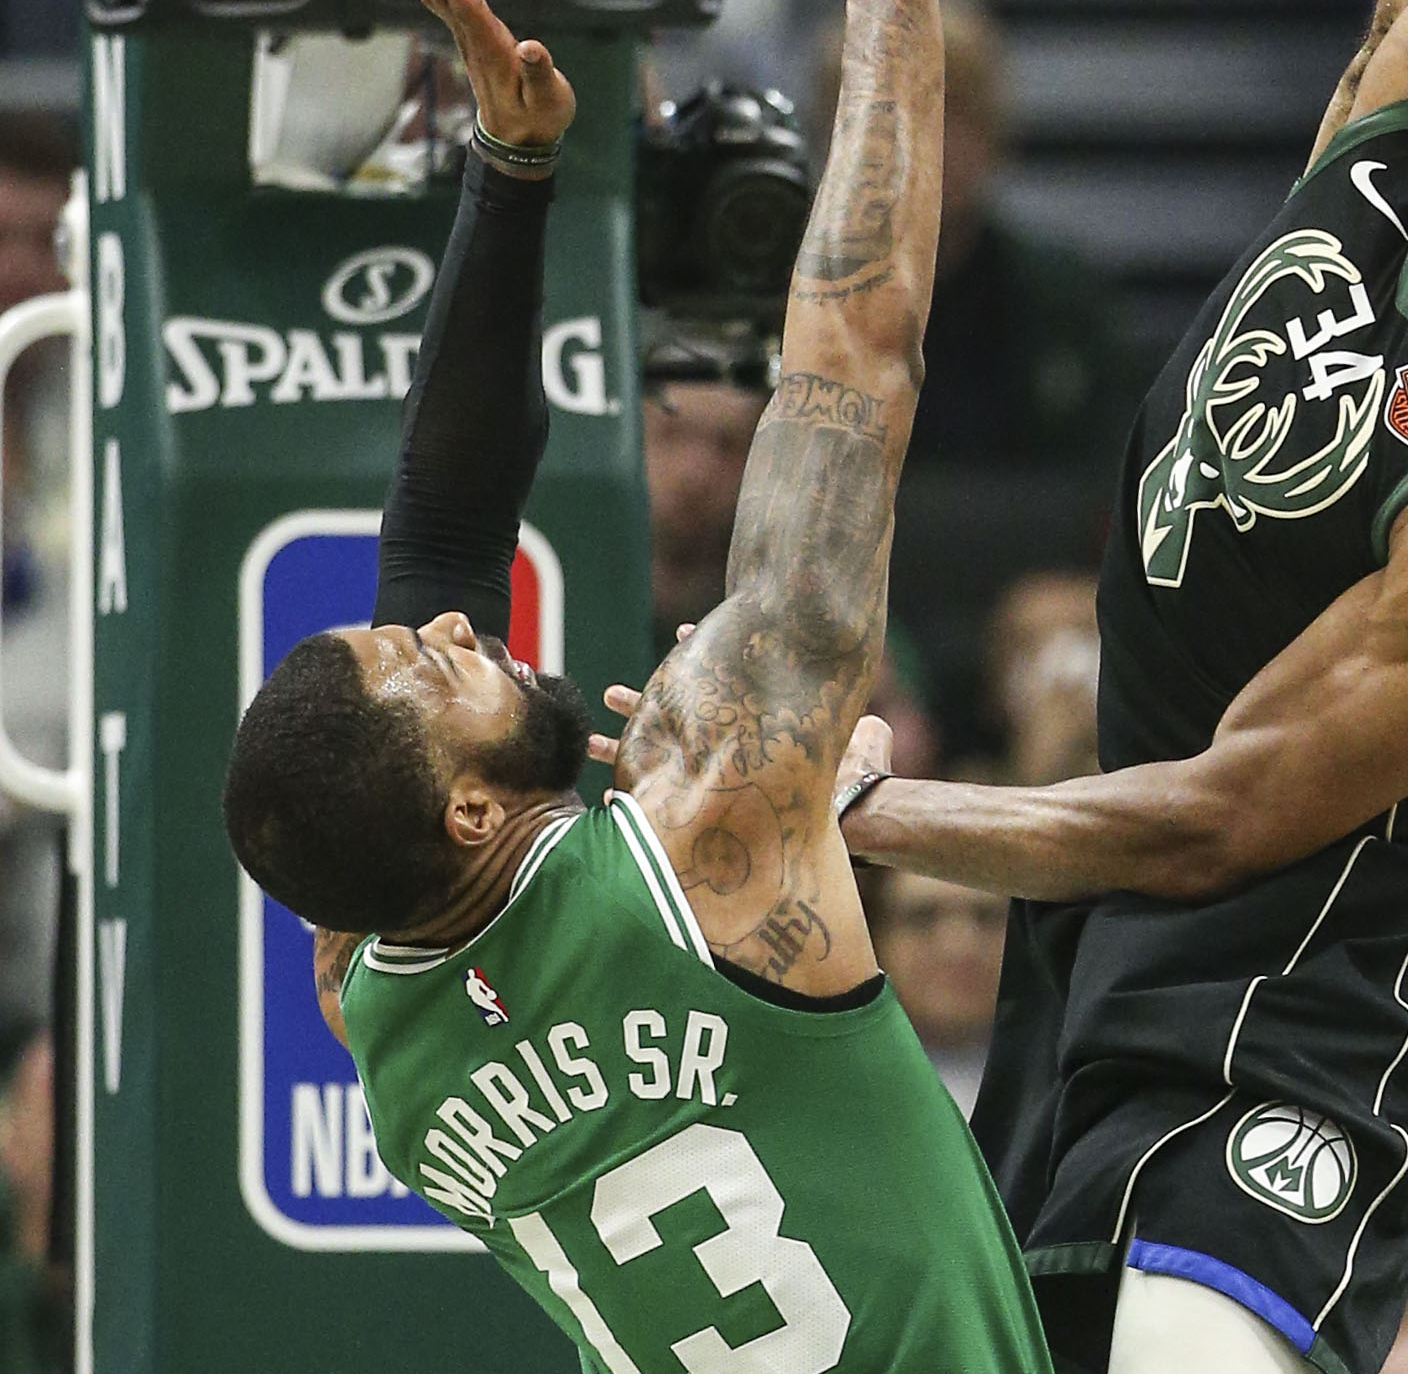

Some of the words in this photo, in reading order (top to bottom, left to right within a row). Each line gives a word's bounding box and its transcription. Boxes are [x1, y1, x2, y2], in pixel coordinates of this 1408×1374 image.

[290, 1081, 409, 1199] NB
[419, 1021, 609, 1229] MORRIS
[622, 1009, 738, 1107] SR.
